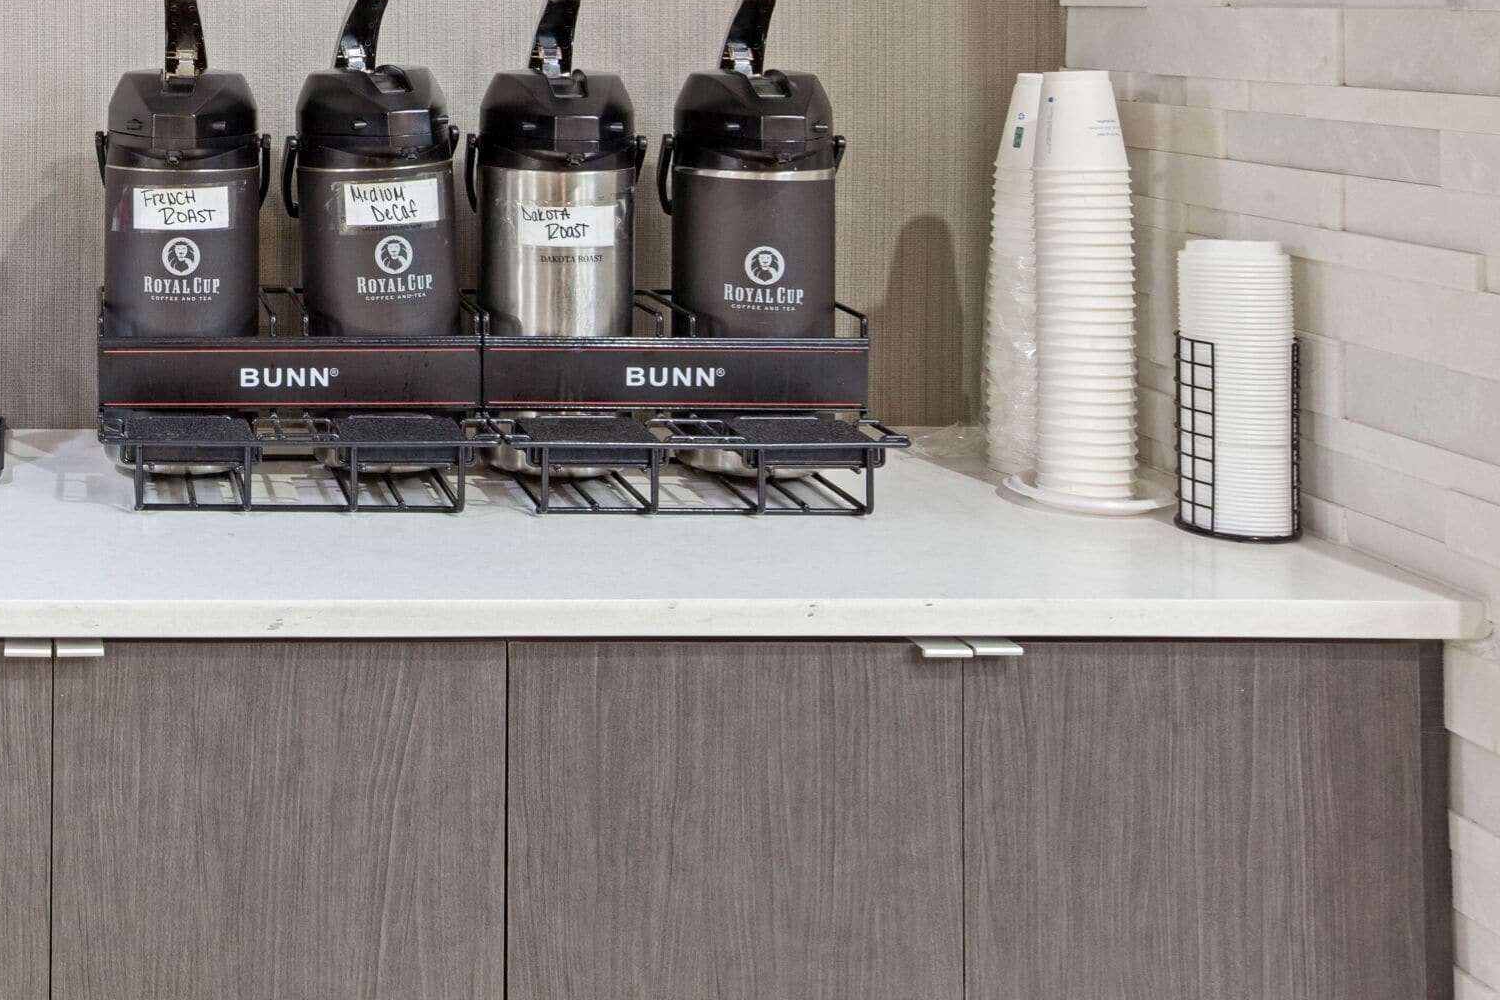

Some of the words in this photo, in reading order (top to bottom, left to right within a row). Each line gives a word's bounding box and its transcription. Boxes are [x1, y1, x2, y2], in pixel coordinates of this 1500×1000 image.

[540, 255, 575, 264] DAKOTA
[578, 254, 604, 263] ROAST
[143, 276, 190, 294] ROYAL
[193, 277, 220, 294] CUP
[357, 276, 405, 293] ROYAL
[408, 274, 433, 290] CUP
[723, 283, 773, 303] ROYAL
[777, 287, 804, 304] CUP
[731, 303, 762, 311] COFFEE
